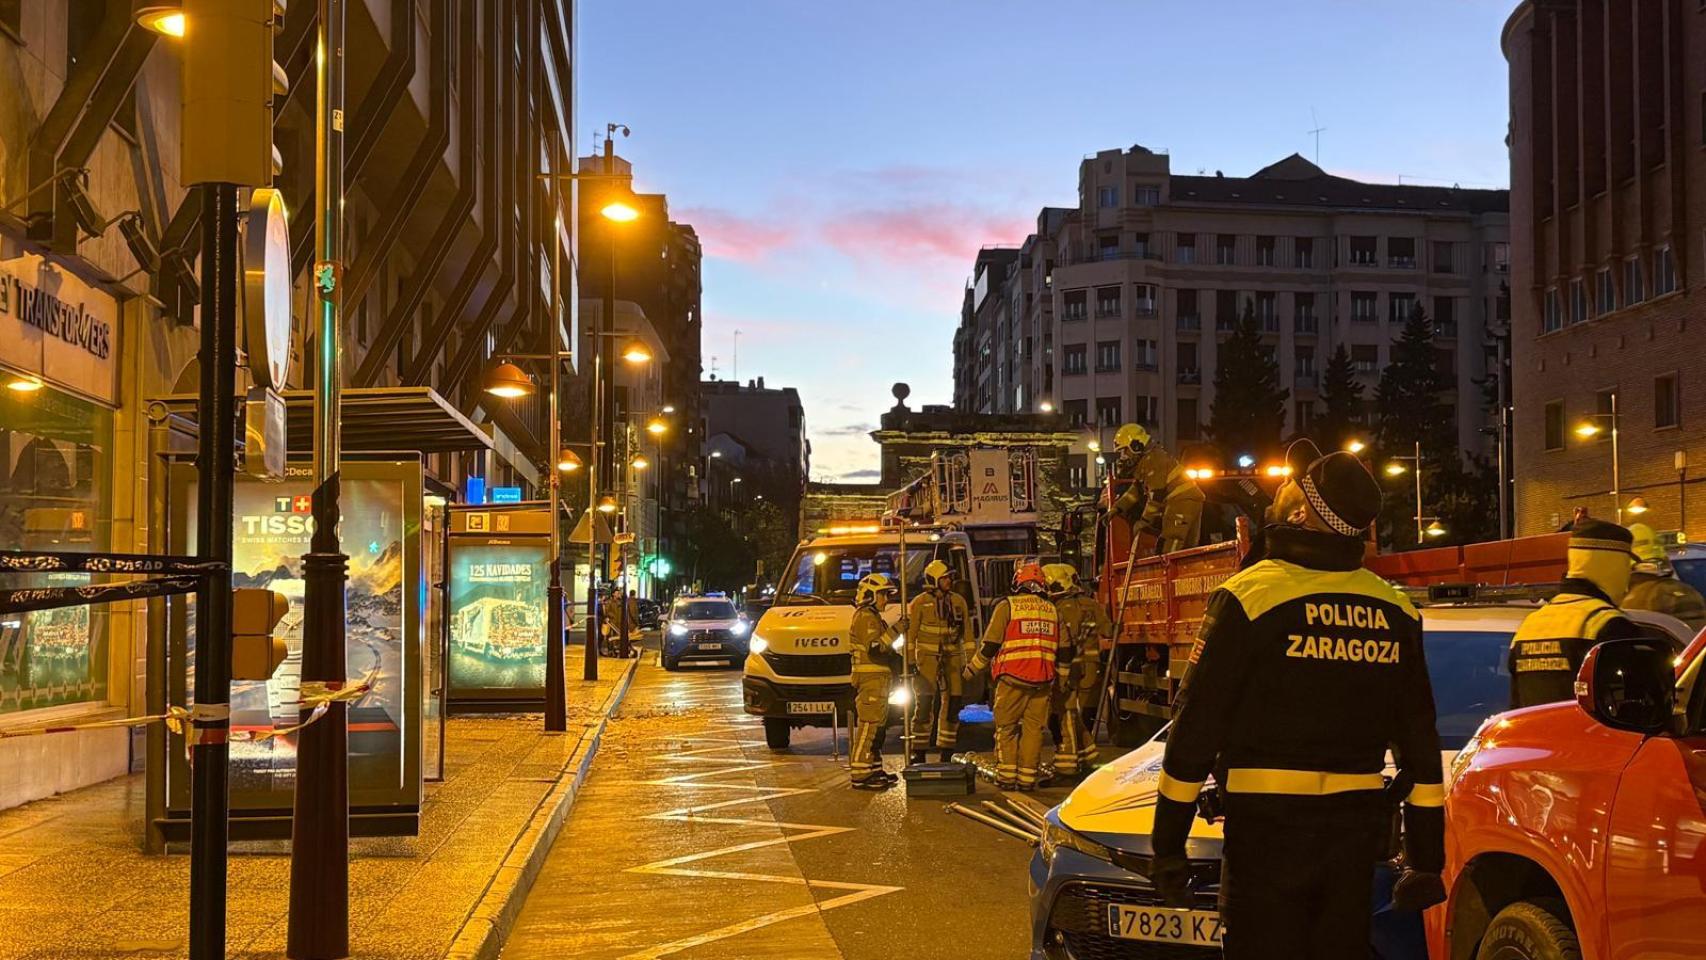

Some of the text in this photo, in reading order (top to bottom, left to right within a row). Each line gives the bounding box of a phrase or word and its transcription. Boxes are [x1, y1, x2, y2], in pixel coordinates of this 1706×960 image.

[14, 278, 110, 360] TRANSFORMERS
[242, 515, 344, 535] TISS
[470, 563, 532, 577] 125 NAVIDADES
[1305, 603, 1390, 629] POLICIA
[794, 637, 840, 648] IVECO
[1286, 634, 1400, 663] ZARAGOZA
[1124, 910, 1222, 943] 7823 KZ
